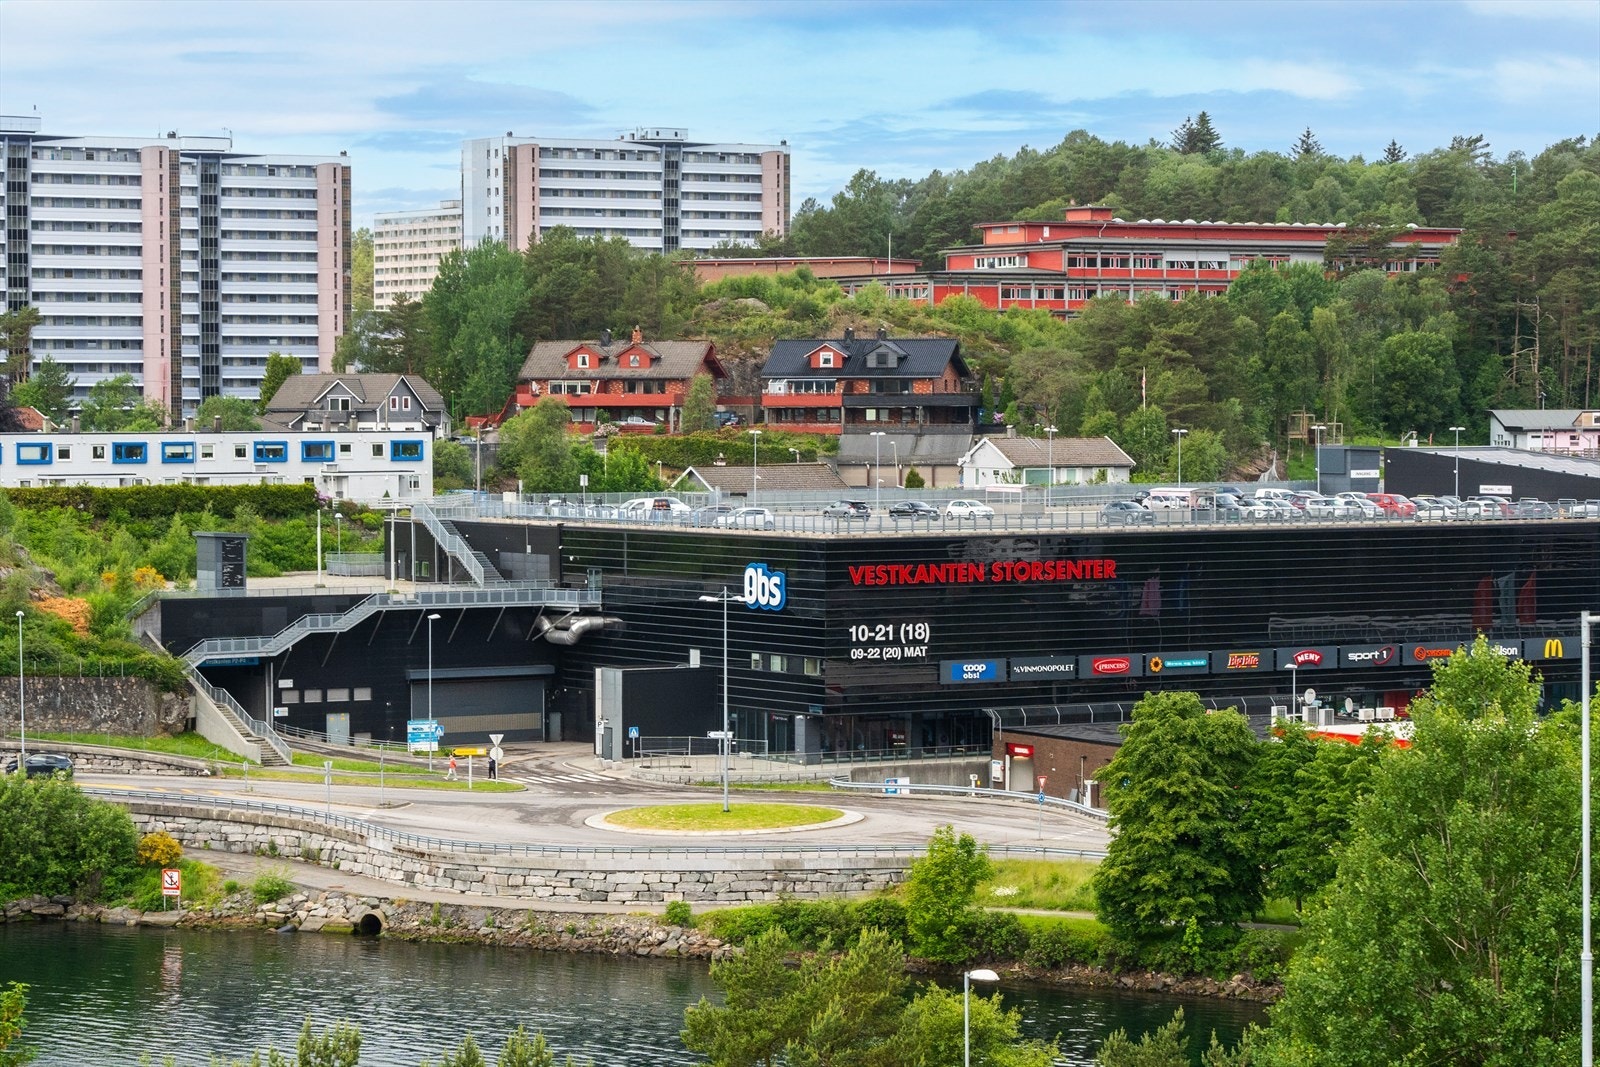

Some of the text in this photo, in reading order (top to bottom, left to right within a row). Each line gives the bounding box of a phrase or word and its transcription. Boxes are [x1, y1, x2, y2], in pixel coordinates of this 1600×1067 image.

[849, 559, 1117, 586] VESTKANTEN STORSENTER
[744, 567, 781, 606] Obs
[849, 622, 930, 644] 10-21 (18)
[850, 646, 928, 661] 09-22 (20) MAT
[1297, 652, 1320, 663] MENY
[1348, 650, 1387, 662] sport 1
[1098, 662, 1126, 671] PRINCESS
[1228, 654, 1259, 669] Big Bite
[963, 664, 986, 673] coop
[1020, 664, 1074, 673] VINMONOPOLET
